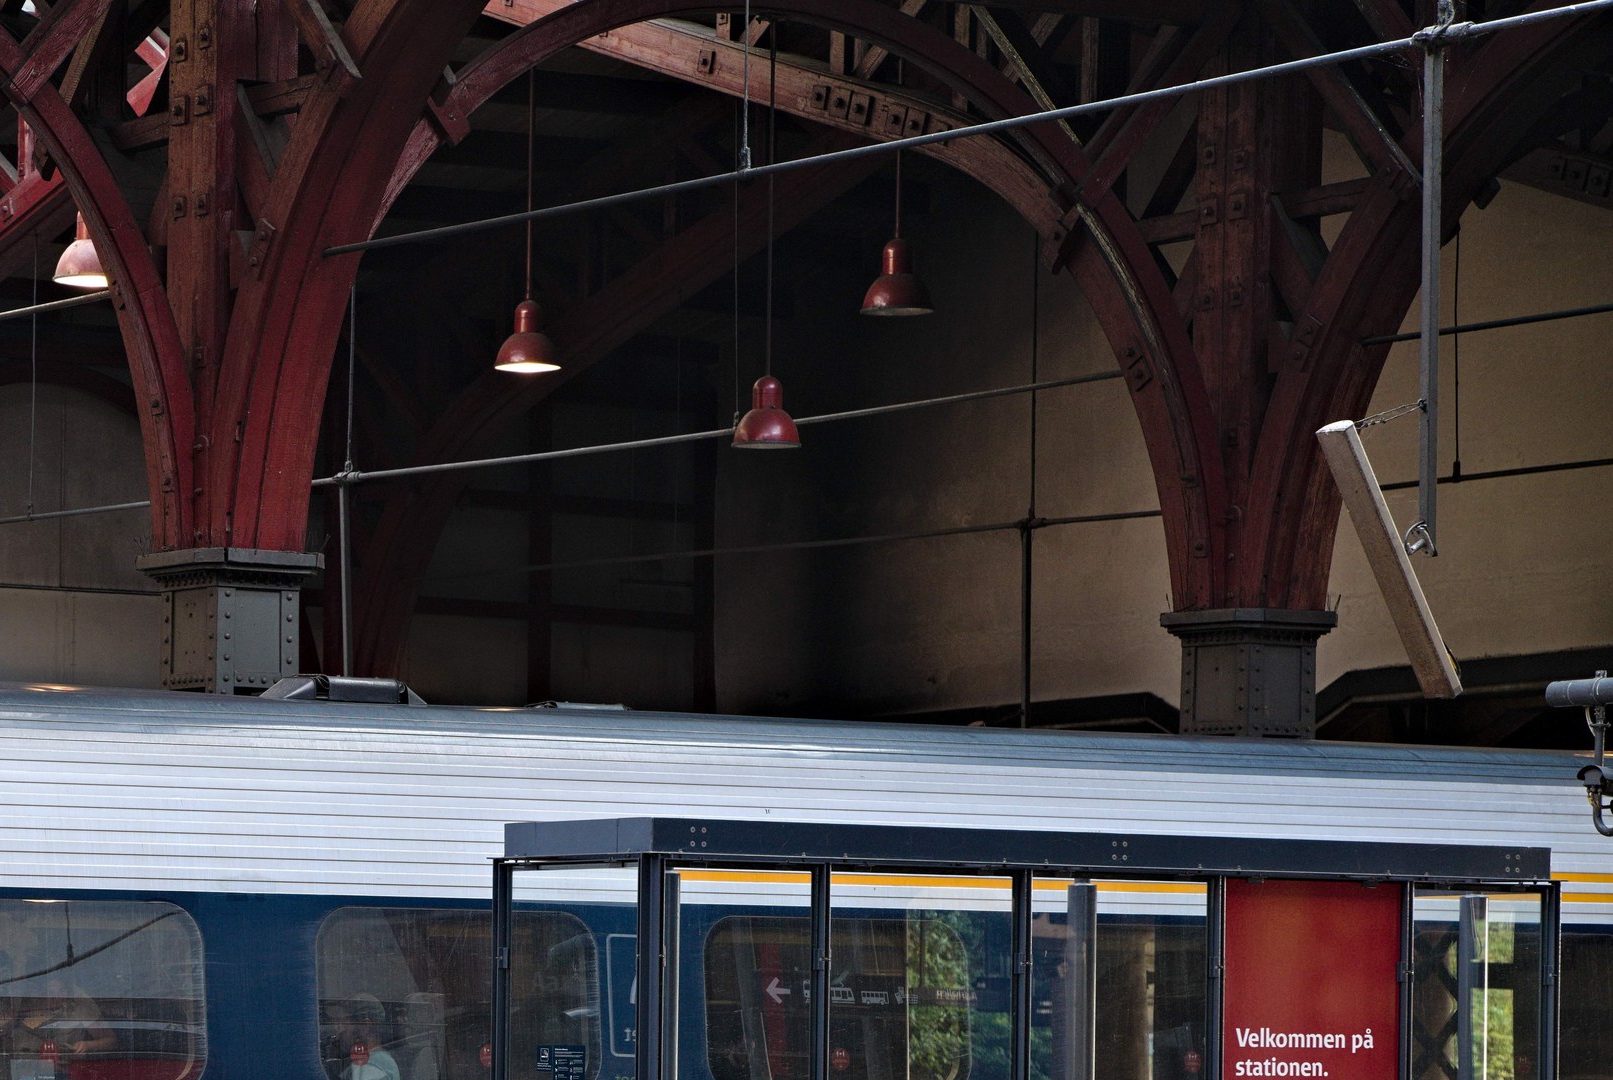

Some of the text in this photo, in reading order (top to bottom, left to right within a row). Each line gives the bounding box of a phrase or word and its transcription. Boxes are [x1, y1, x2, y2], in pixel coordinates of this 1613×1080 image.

[1235, 1027, 1374, 1053] Velkommen på
[1235, 1057, 1328, 1077] stationen.
